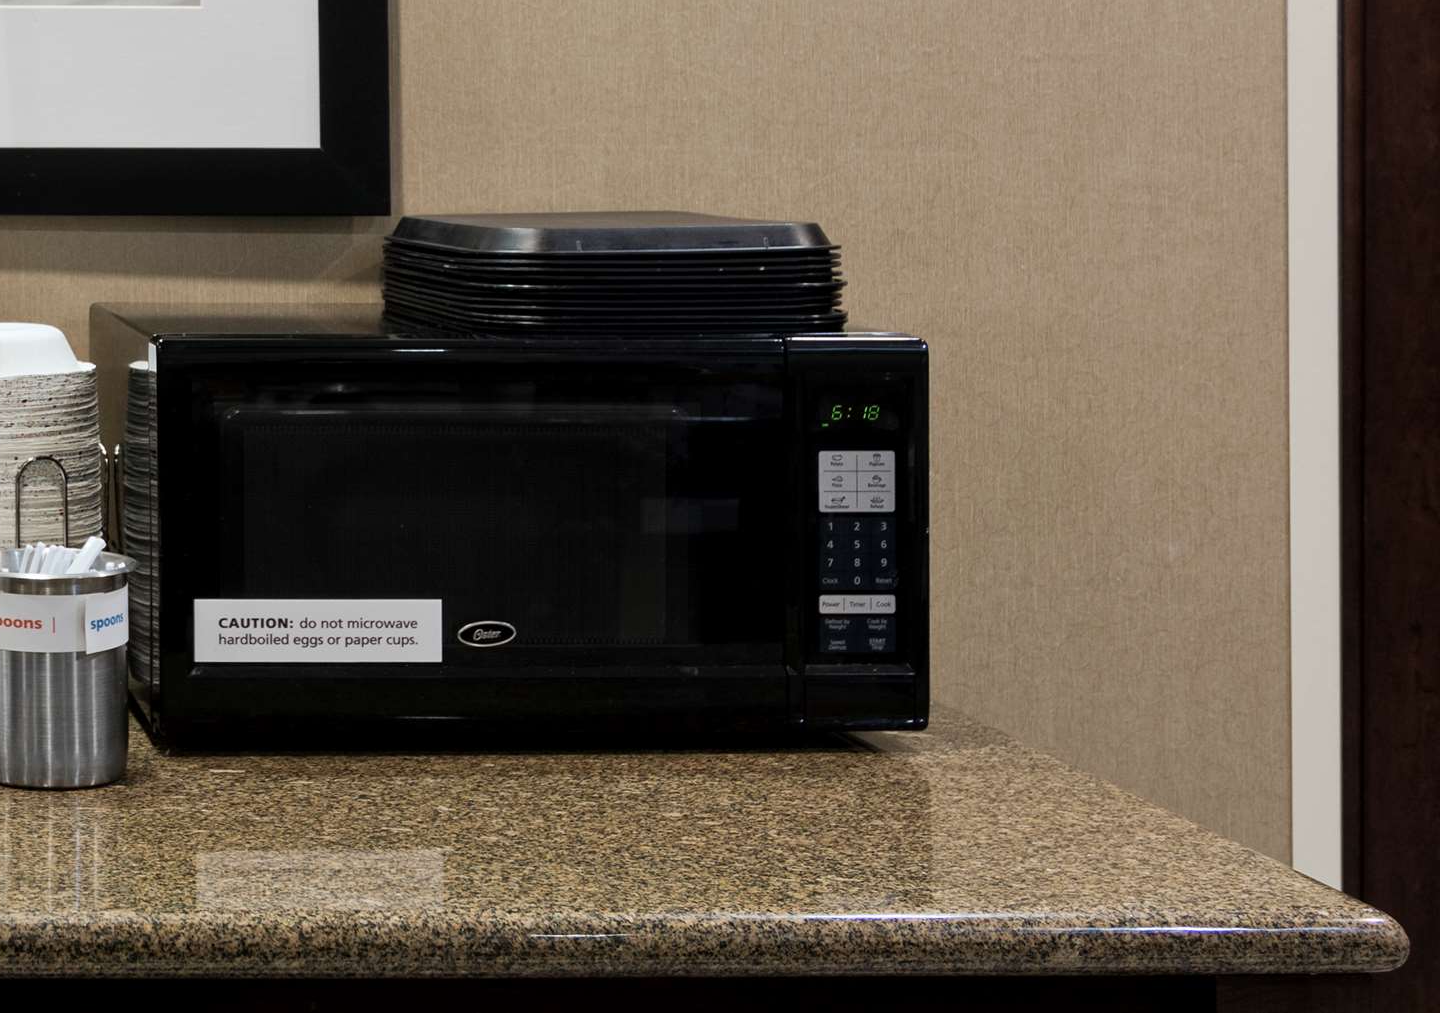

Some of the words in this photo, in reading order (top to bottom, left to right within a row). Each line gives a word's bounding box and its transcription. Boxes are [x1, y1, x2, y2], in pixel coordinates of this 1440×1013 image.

[831, 404, 881, 421] 6:18
[827, 521, 833, 531] 1
[853, 521, 861, 531] 2
[880, 521, 888, 532] 3
[826, 539, 834, 549] 4
[853, 539, 861, 549] 5
[880, 539, 888, 549] 6
[827, 557, 834, 568] 7
[853, 557, 861, 568] 8
[880, 557, 888, 568] 9
[853, 575, 861, 586] 0
[90, 612, 124, 632] spoons
[218, 617, 294, 629] CAUTION:
[299, 617, 317, 629] do
[321, 618, 343, 629] not
[347, 617, 419, 629] microwave
[218, 633, 289, 645] hardboiled
[293, 636, 324, 648] eggs
[327, 636, 341, 645] or
[345, 636, 383, 648] paper
[386, 636, 419, 648] cups.
